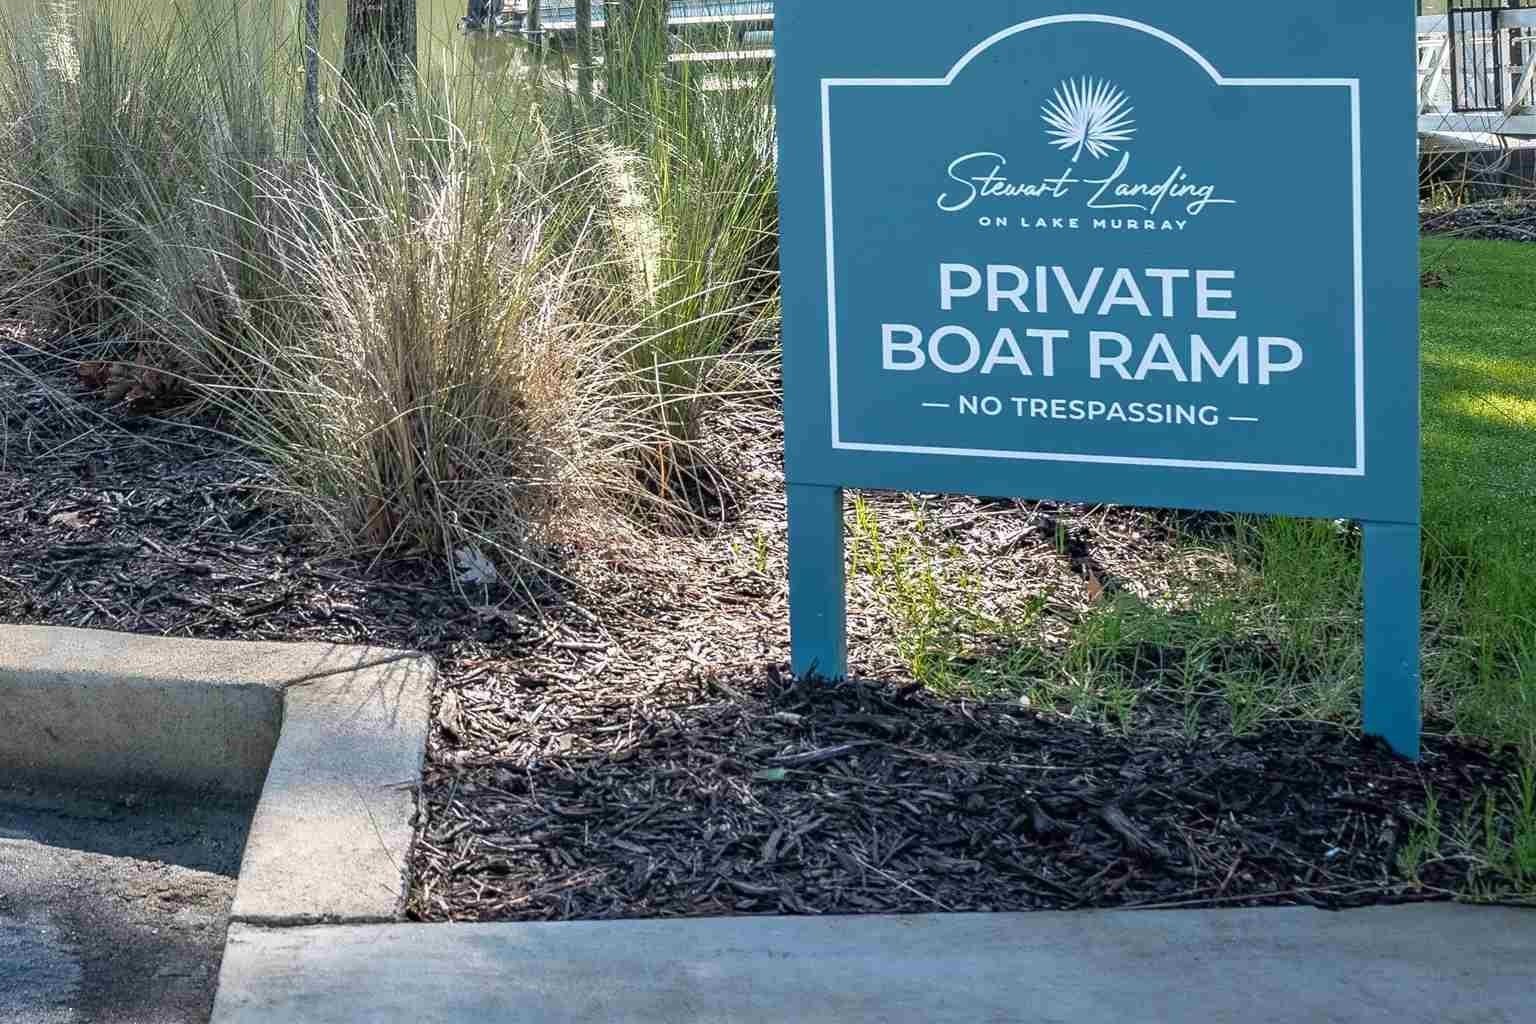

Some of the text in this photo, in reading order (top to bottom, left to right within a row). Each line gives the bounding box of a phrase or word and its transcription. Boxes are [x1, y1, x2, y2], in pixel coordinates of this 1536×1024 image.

[937, 152, 1236, 217] Stewart Landing
[978, 216, 1187, 231] ON LAKE MURRAY
[940, 263, 1237, 320] PRIVATE
[881, 323, 1303, 385] BOAT RAMP
[959, 395, 1219, 426] NO TRESPASSING
